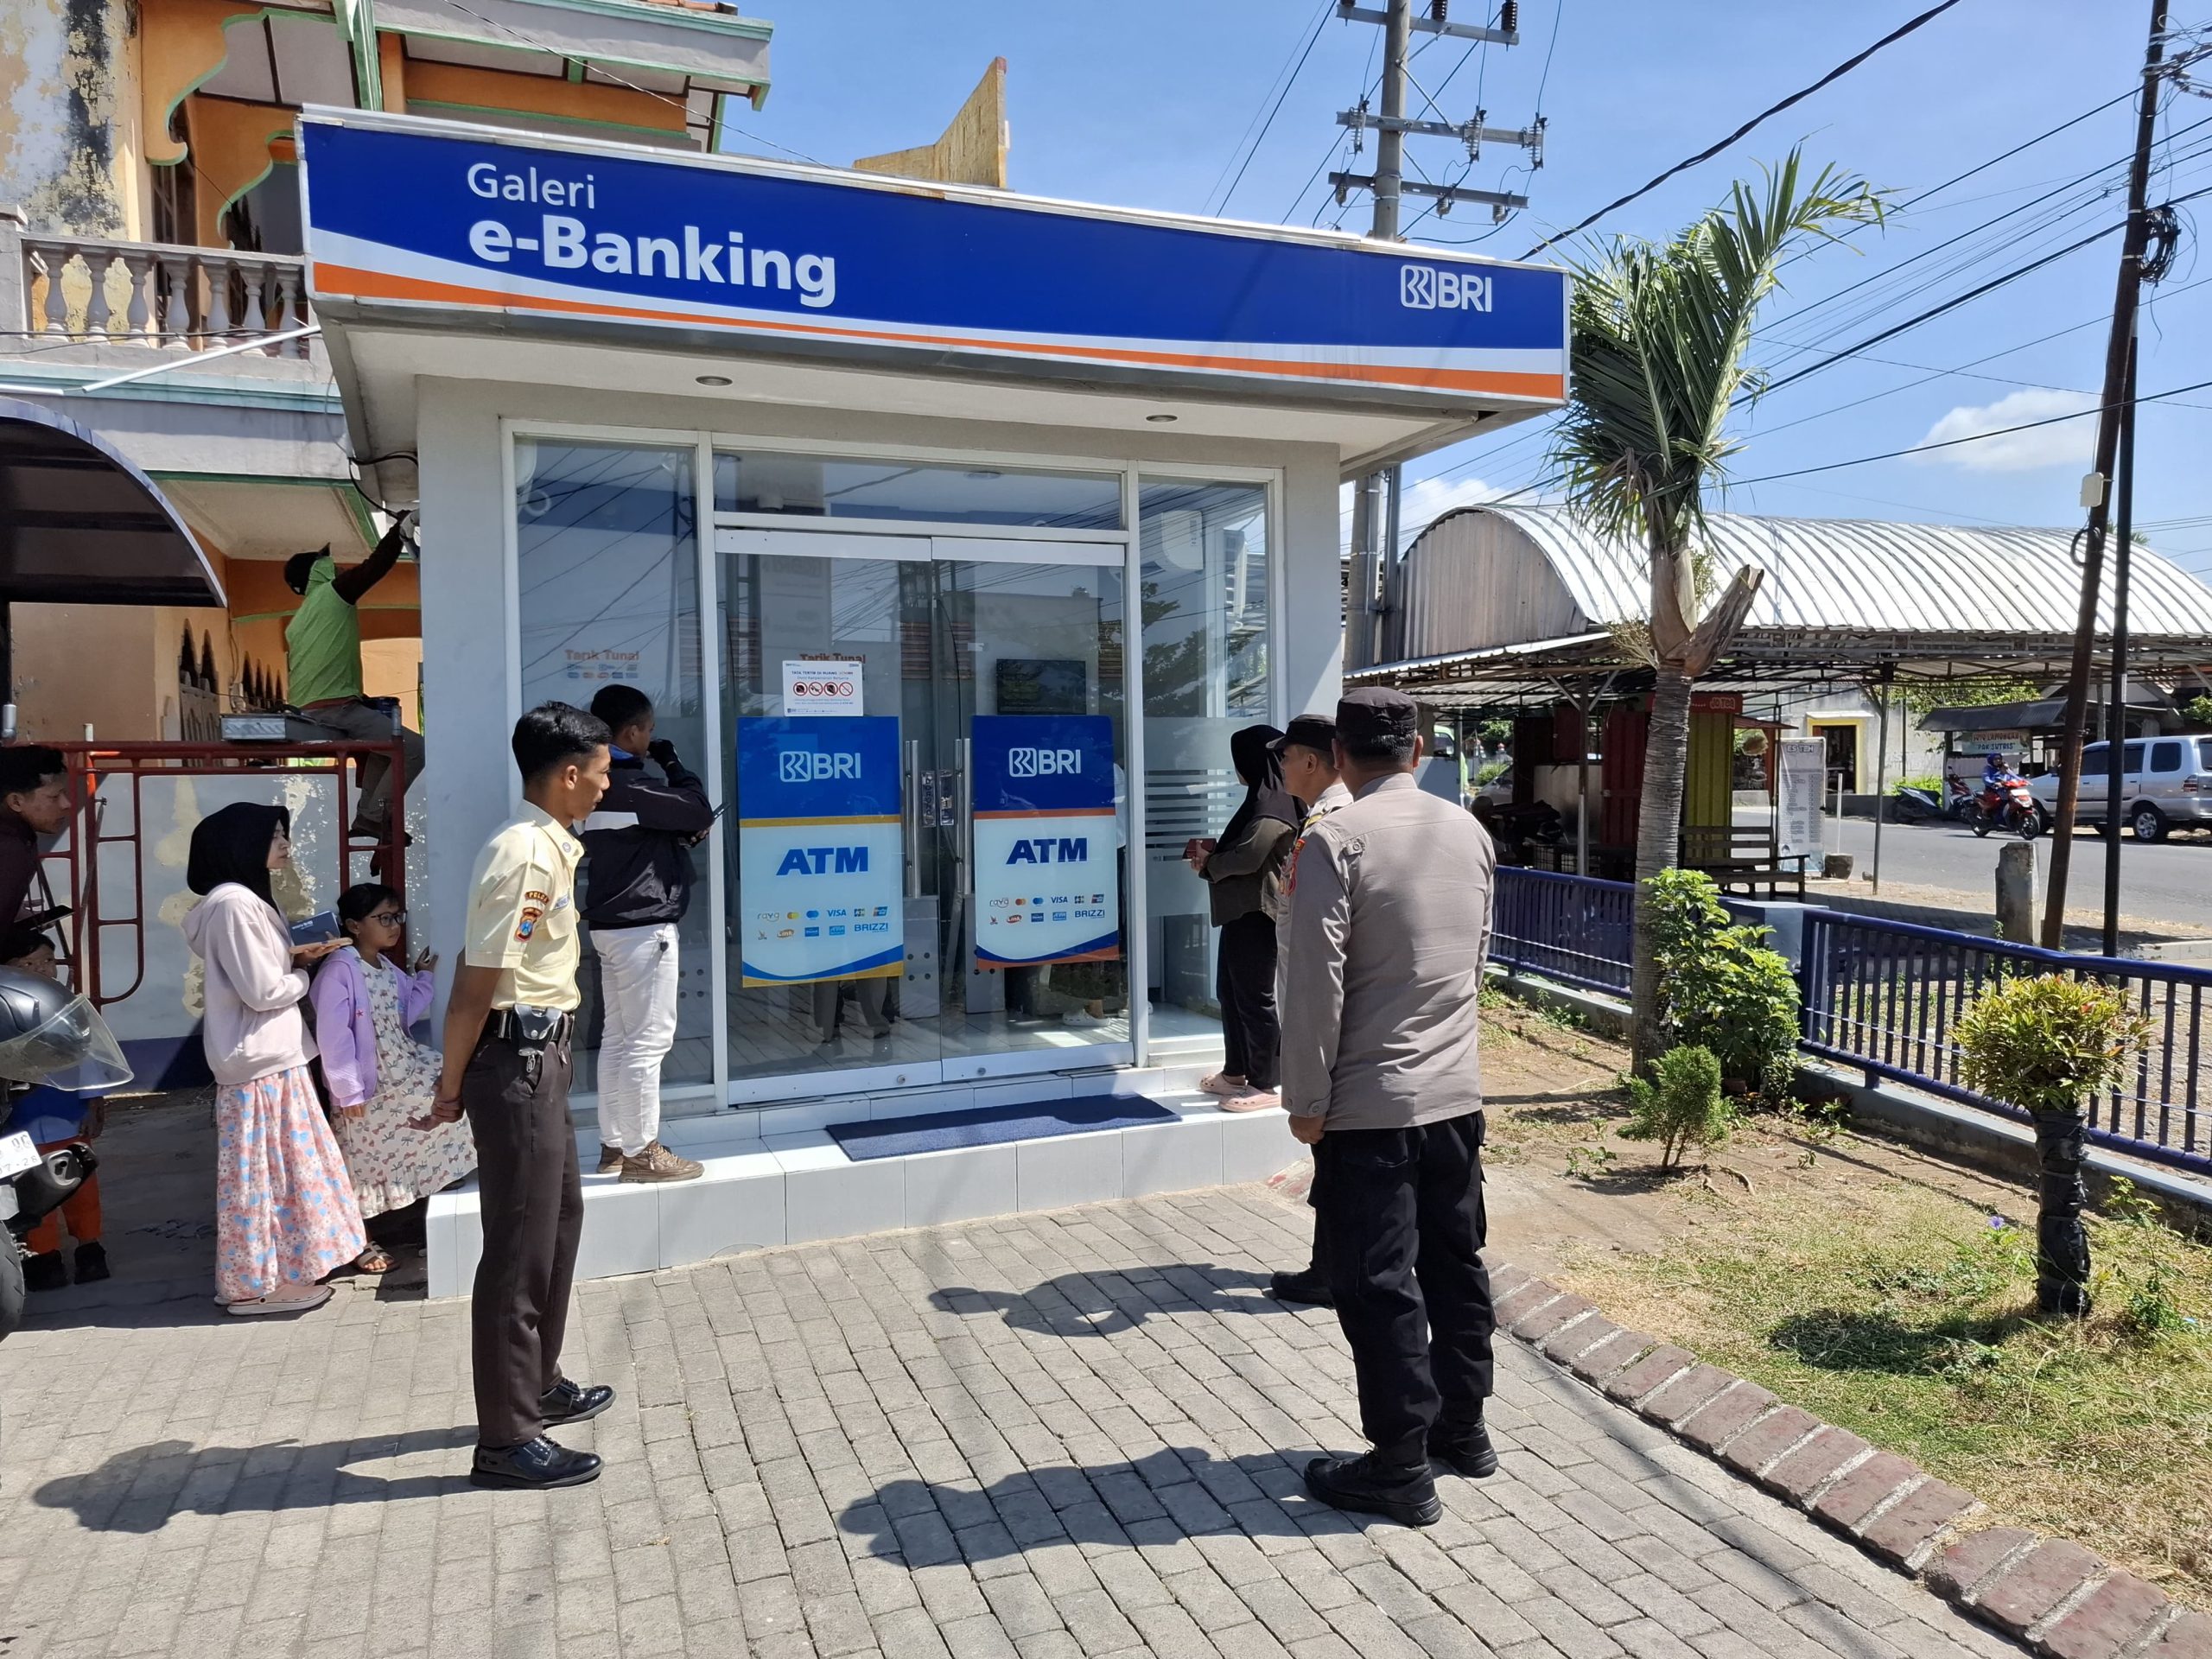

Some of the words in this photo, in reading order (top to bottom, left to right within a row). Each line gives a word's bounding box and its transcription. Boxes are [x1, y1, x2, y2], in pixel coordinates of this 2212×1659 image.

[467, 162, 595, 209] Galeri
[468, 214, 836, 308] e-Banking
[1438, 271, 1492, 312] BRI
[813, 753, 861, 779] BRI
[1038, 749, 1081, 775] BRI
[776, 846, 868, 876] ATM
[1006, 837, 1088, 865] ATM
[827, 908, 847, 917] VISA
[1074, 909, 1105, 918] BRIZZI
[854, 922, 888, 931] BRIZZI
